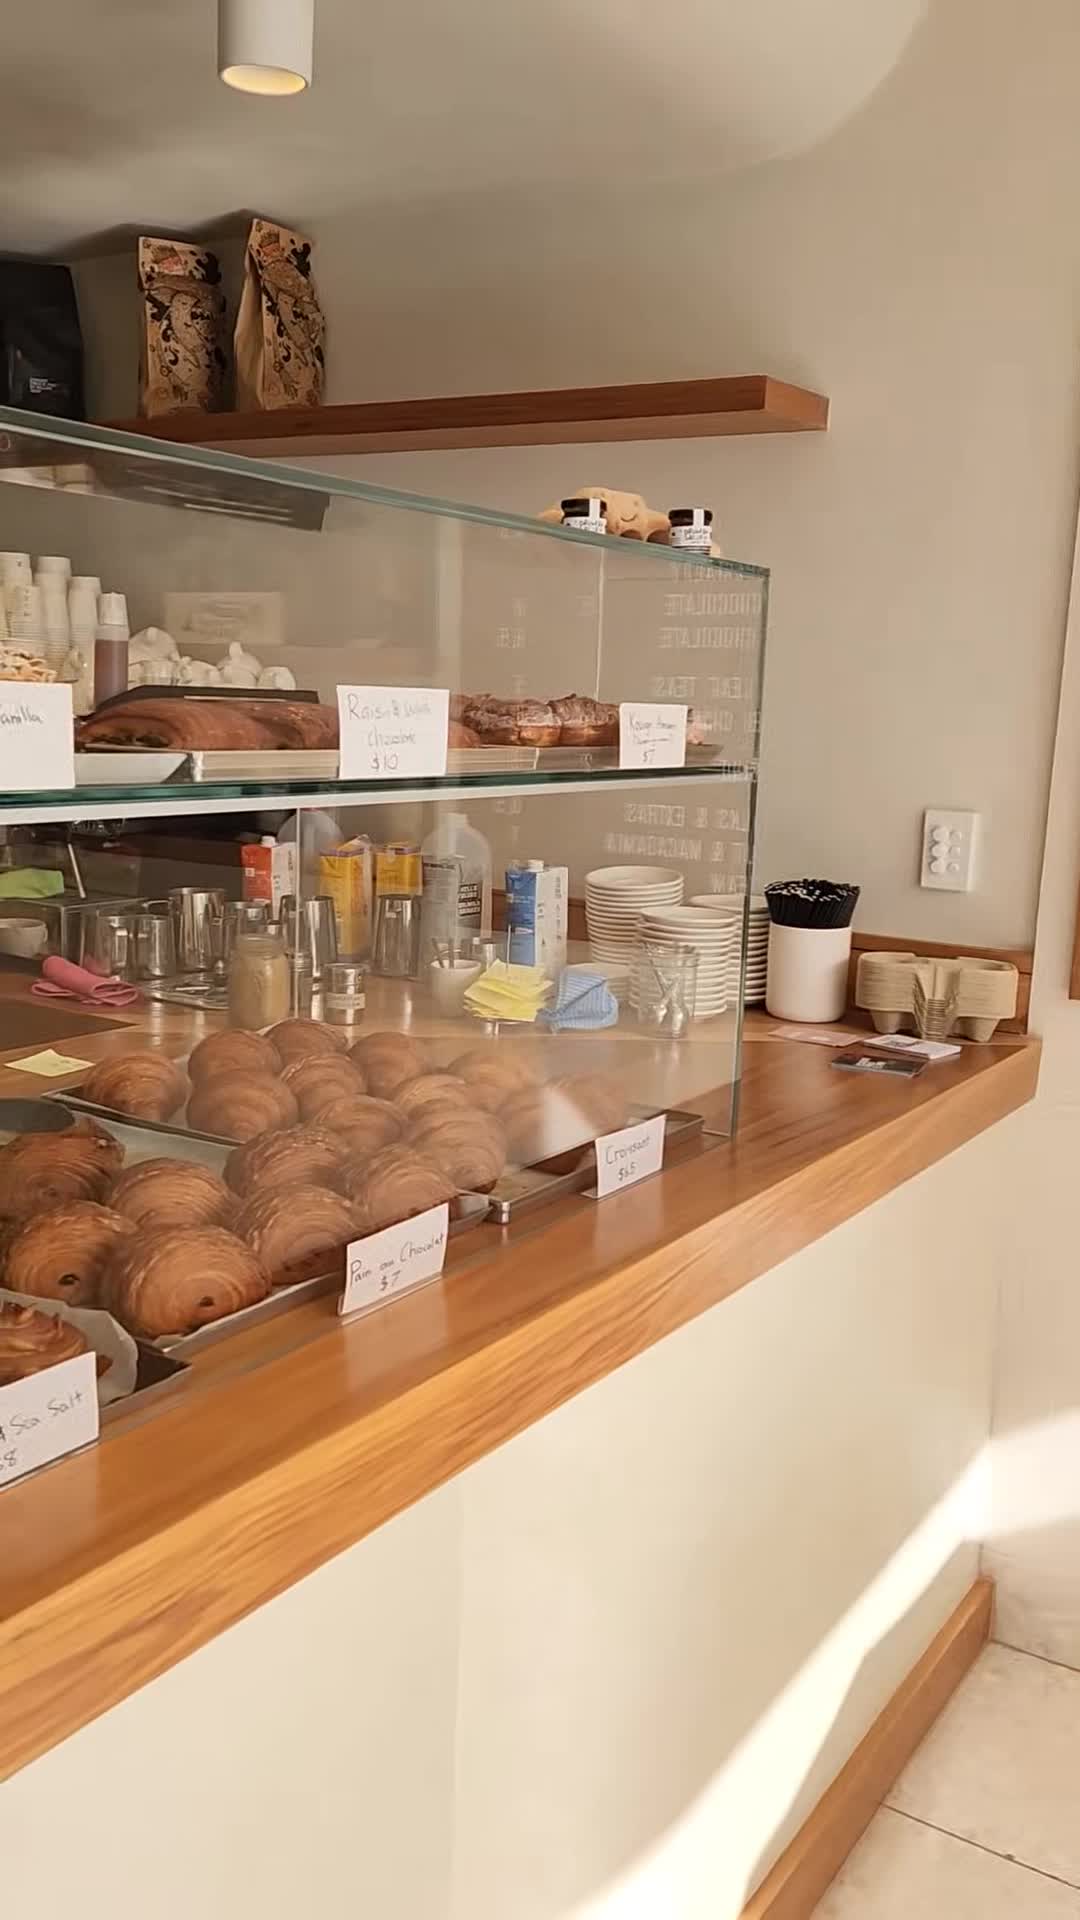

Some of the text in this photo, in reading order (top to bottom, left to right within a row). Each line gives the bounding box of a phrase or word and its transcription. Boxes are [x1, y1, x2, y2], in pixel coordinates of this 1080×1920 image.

[0, 703, 44, 725] anilla
[351, 1259, 372, 1289] Pain
[380, 1270, 401, 1292] $7
[47, 1389, 83, 1417] Salt
